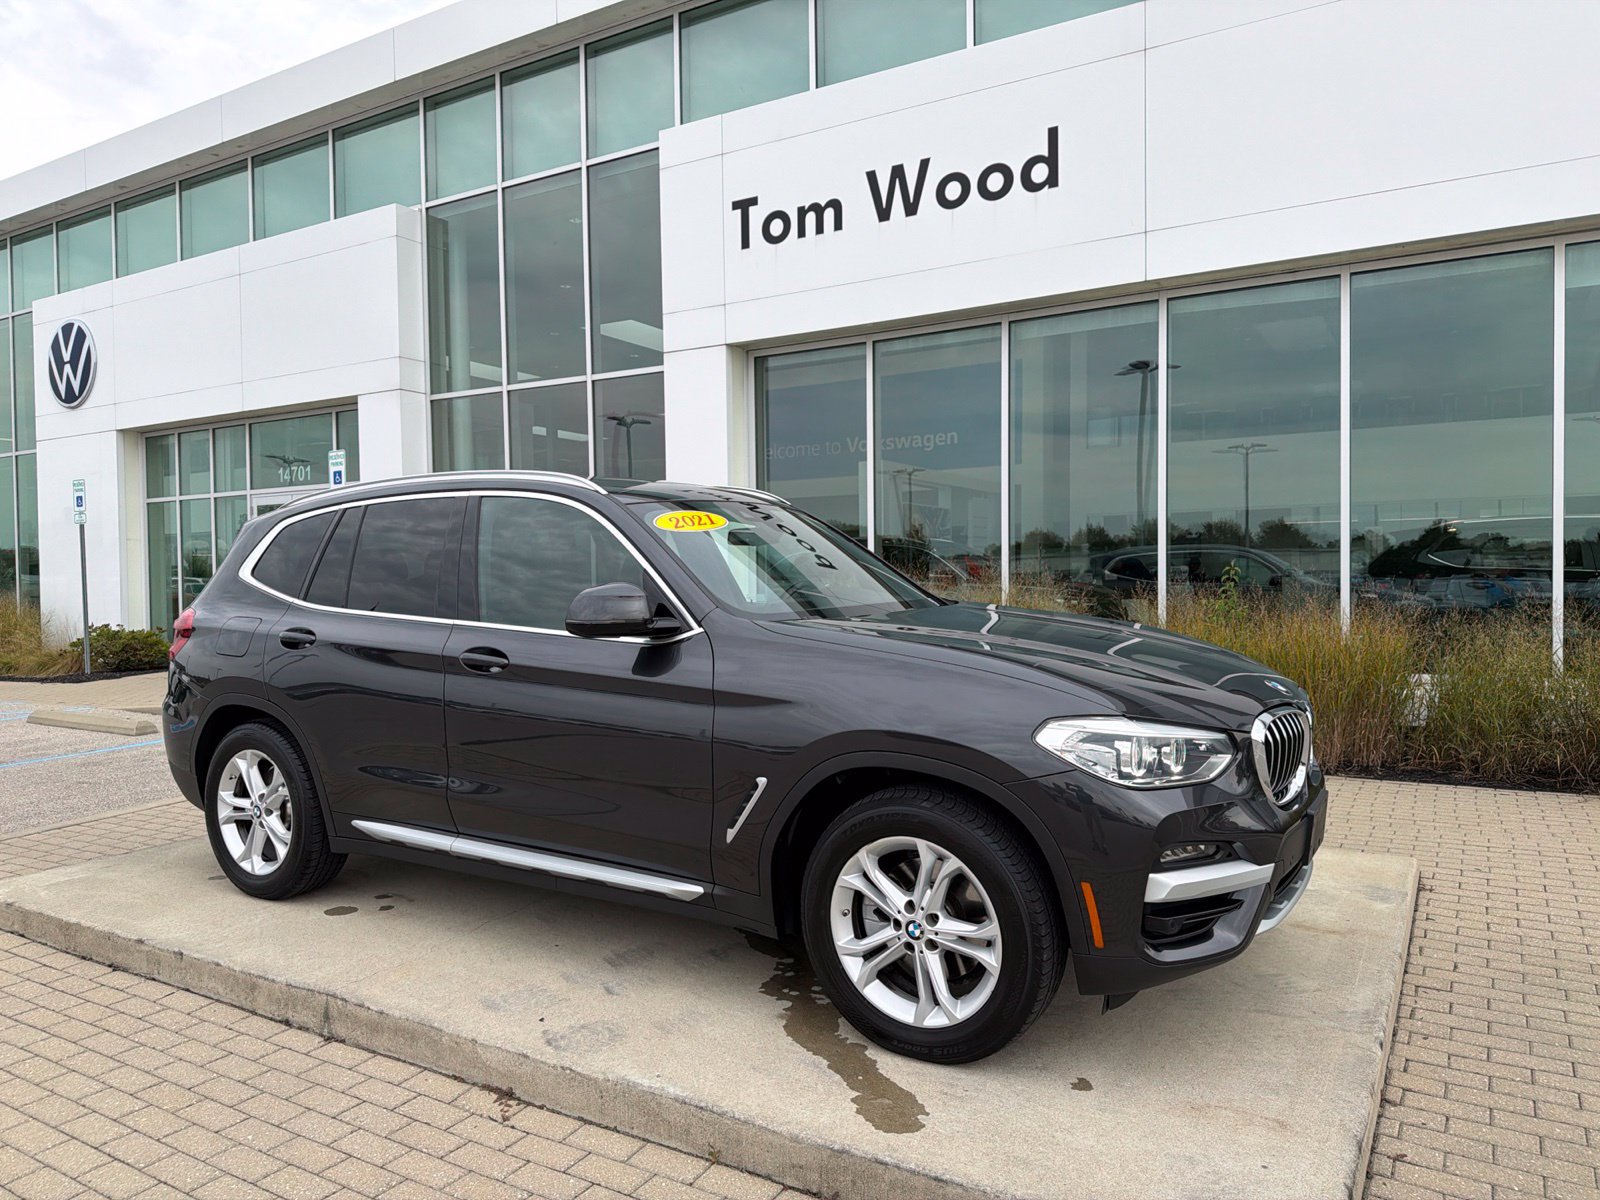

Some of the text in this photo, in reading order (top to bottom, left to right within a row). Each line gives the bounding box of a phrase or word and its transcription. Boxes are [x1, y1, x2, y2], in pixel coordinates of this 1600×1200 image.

[731, 125, 1059, 250] Tom Wood
[48, 319, 95, 404] VW
[766, 442, 821, 461] elcome
[825, 440, 841, 456] to
[278, 465, 312, 482] 14701
[668, 513, 717, 529] 2021
